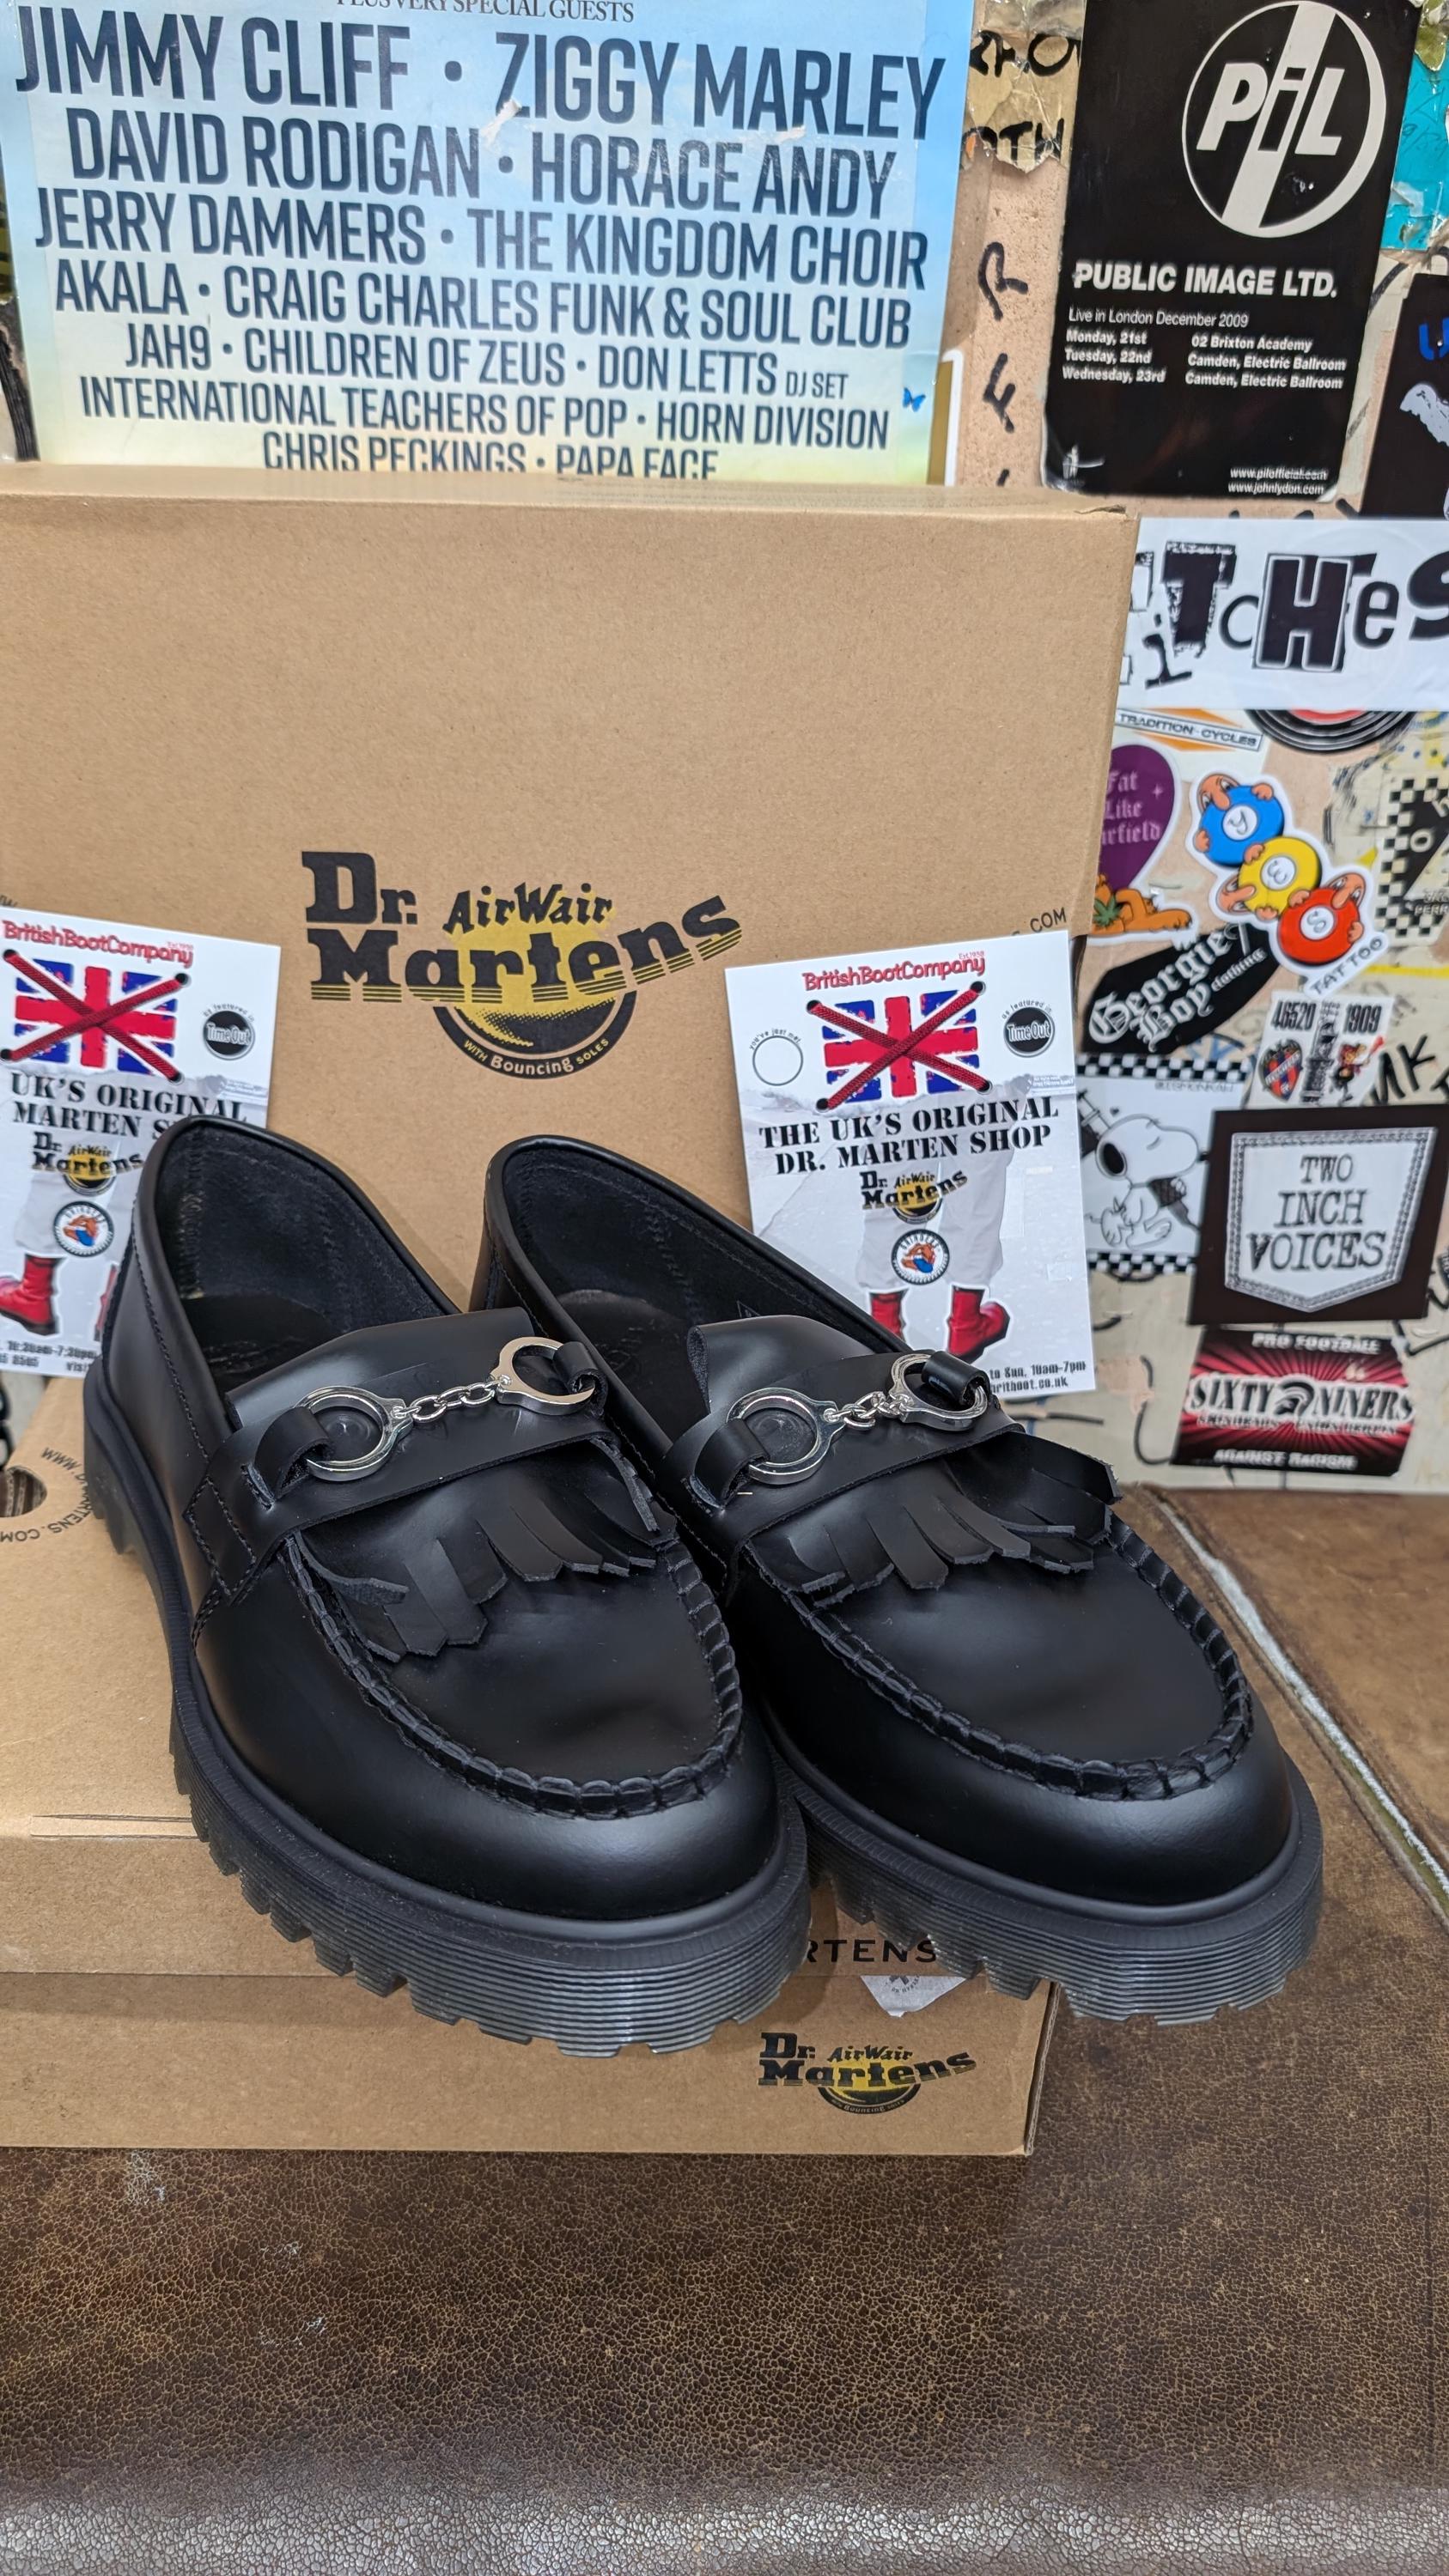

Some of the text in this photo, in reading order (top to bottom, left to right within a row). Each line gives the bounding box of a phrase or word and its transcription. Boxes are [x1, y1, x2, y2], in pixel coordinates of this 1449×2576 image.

[549, 0, 634, 22] GUESTS
[15, 5, 411, 111] JIMMY CLIFF
[495, 31, 679, 127] ZIGGY
[693, 43, 946, 141] MARLEY
[65, 107, 480, 199] DAVID RODIGAN
[531, 131, 897, 221] HORACE ANDY
[35, 186, 426, 265] JERRY DAMMERS
[467, 208, 929, 291] THE KINGDOM CHOIR
[55, 258, 189, 316] AKALA
[1074, 259, 1338, 299] PUBLIC IMAGE LTD.
[222, 264, 912, 349] CRAIG CHARLES FUNK & SOUL CLUB
[1068, 307, 1249, 328] Live in London December 2009
[125, 323, 212, 372] JAH9
[1064, 346, 1153, 366] Tuesday, 22nd
[1066, 327, 1148, 346] Monday, 21st
[1210, 332, 1255, 349] Brixton
[1257, 335, 1313, 354] Academy
[244, 327, 566, 387] CHILDREN OF ZEUS
[599, 345, 849, 400] DON LETTS DJ SET
[1062, 364, 1167, 384] Wednesday, 23rd
[1187, 351, 1347, 371] Camden, Electric Ballroom
[1184, 369, 1343, 389] Camden, Electric Ballroom
[80, 375, 628, 440] INTERNATIONAL TEACHERS OF POP
[656, 401, 890, 450] HORN DIVISION
[263, 431, 359, 471] CHRIS
[556, 442, 634, 478] PAPA
[1227, 480, 1324, 495] www.johnlydon.com
[1118, 714, 1257, 746] TRADITION CYCLES
[301, 850, 418, 925] Dr.
[441, 882, 614, 936] AirWair
[2, 919, 194, 969] BritishBootCompany
[306, 895, 742, 1004] Martens
[801, 957, 986, 992] BritishBootCompany
[1309, 935, 1383, 995] TATTOO
[1270, 999, 1317, 1031] 46520
[1343, 1003, 1383, 1035] 1909
[463, 1036, 610, 1076] WITH Bouncing SOLES
[13, 1100, 142, 1139] MARTEN
[97, 1084, 247, 1122] ORIGINAL
[758, 1122, 819, 1149] THE
[912, 1096, 1059, 1133] ORIGINAL
[32, 1151, 144, 1172] Martens
[776, 1124, 1051, 1175] DR. MARTEN SHOP
[1300, 1153, 1354, 1184] TWO
[861, 1170, 968, 1210] Martens
[1273, 1188, 1370, 1228] INCH
[1245, 1230, 1387, 1272] VOICES
[1251, 1333, 1291, 1349] PRO
[1190, 1376, 1414, 1421] SIXTY NINERS
[759, 2032, 815, 2059] Dr.
[826, 2044, 914, 2063] AirWair
[758, 2051, 977, 2087] Martens
